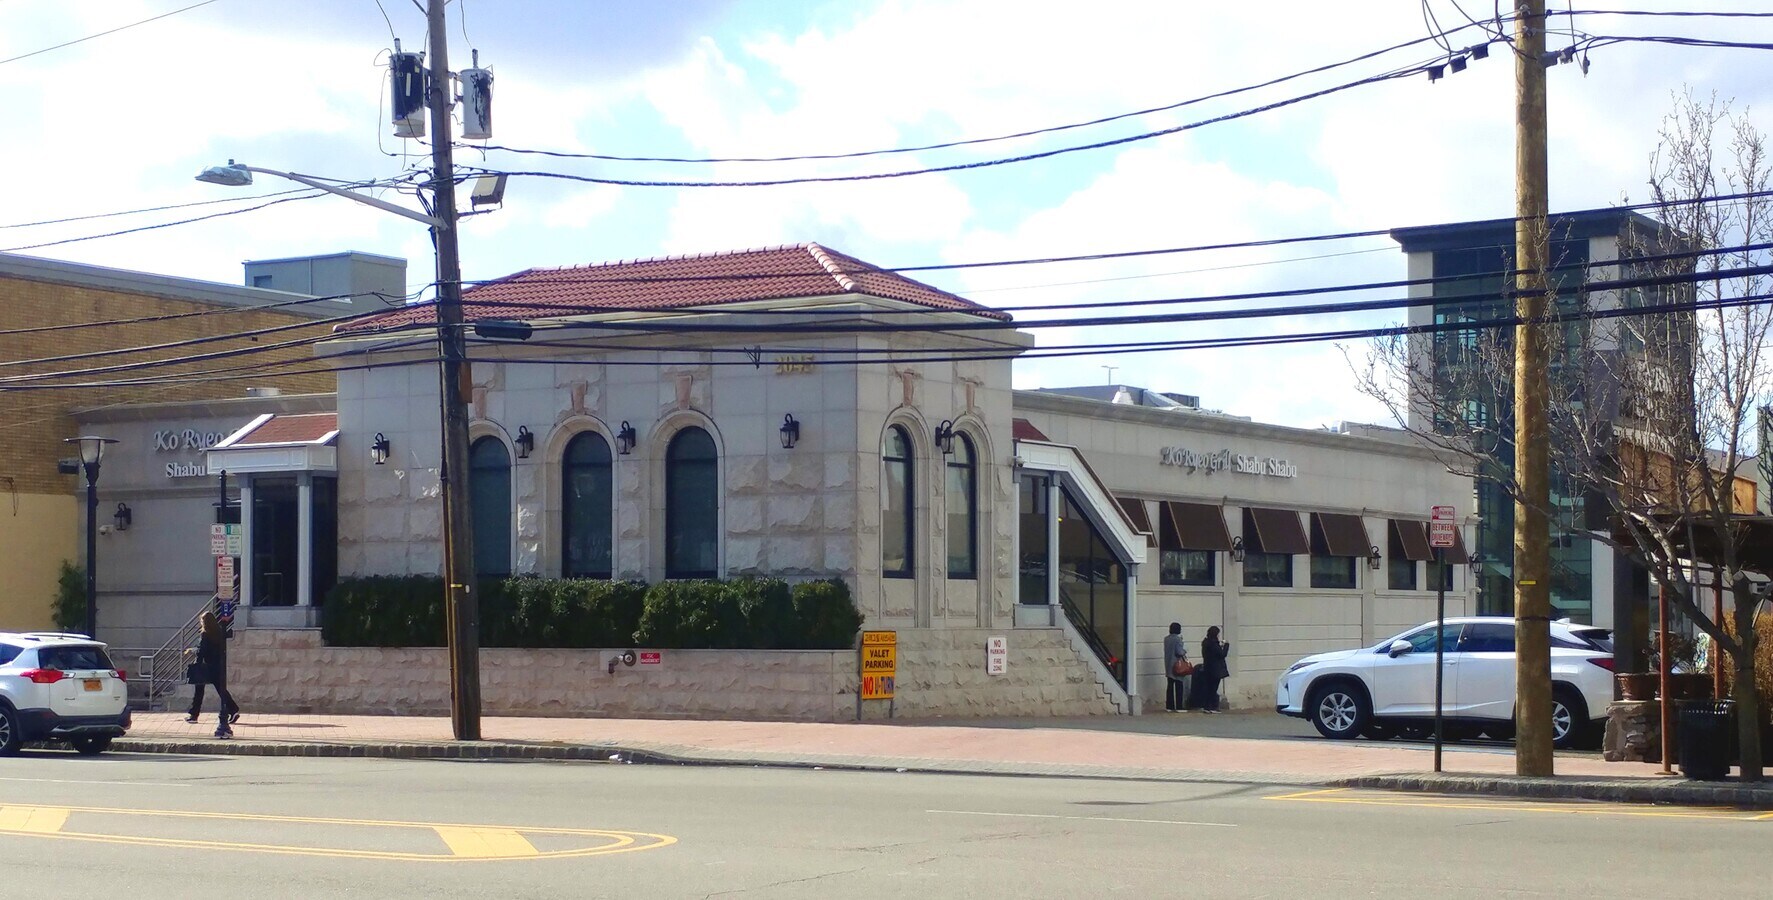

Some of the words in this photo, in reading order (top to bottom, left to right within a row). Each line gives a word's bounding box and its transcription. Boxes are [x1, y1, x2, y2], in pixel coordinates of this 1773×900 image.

[153, 430, 179, 451] Ko
[181, 429, 224, 454] Ryeo
[165, 462, 206, 478] Shabu
[1236, 454, 1267, 475] Shabu
[1268, 457, 1298, 478] Shabu
[993, 639, 1002, 648] NO
[869, 649, 890, 658] VALET
[864, 659, 894, 669] PARKING
[863, 676, 874, 695] NO
[875, 676, 895, 695] U-TURN
